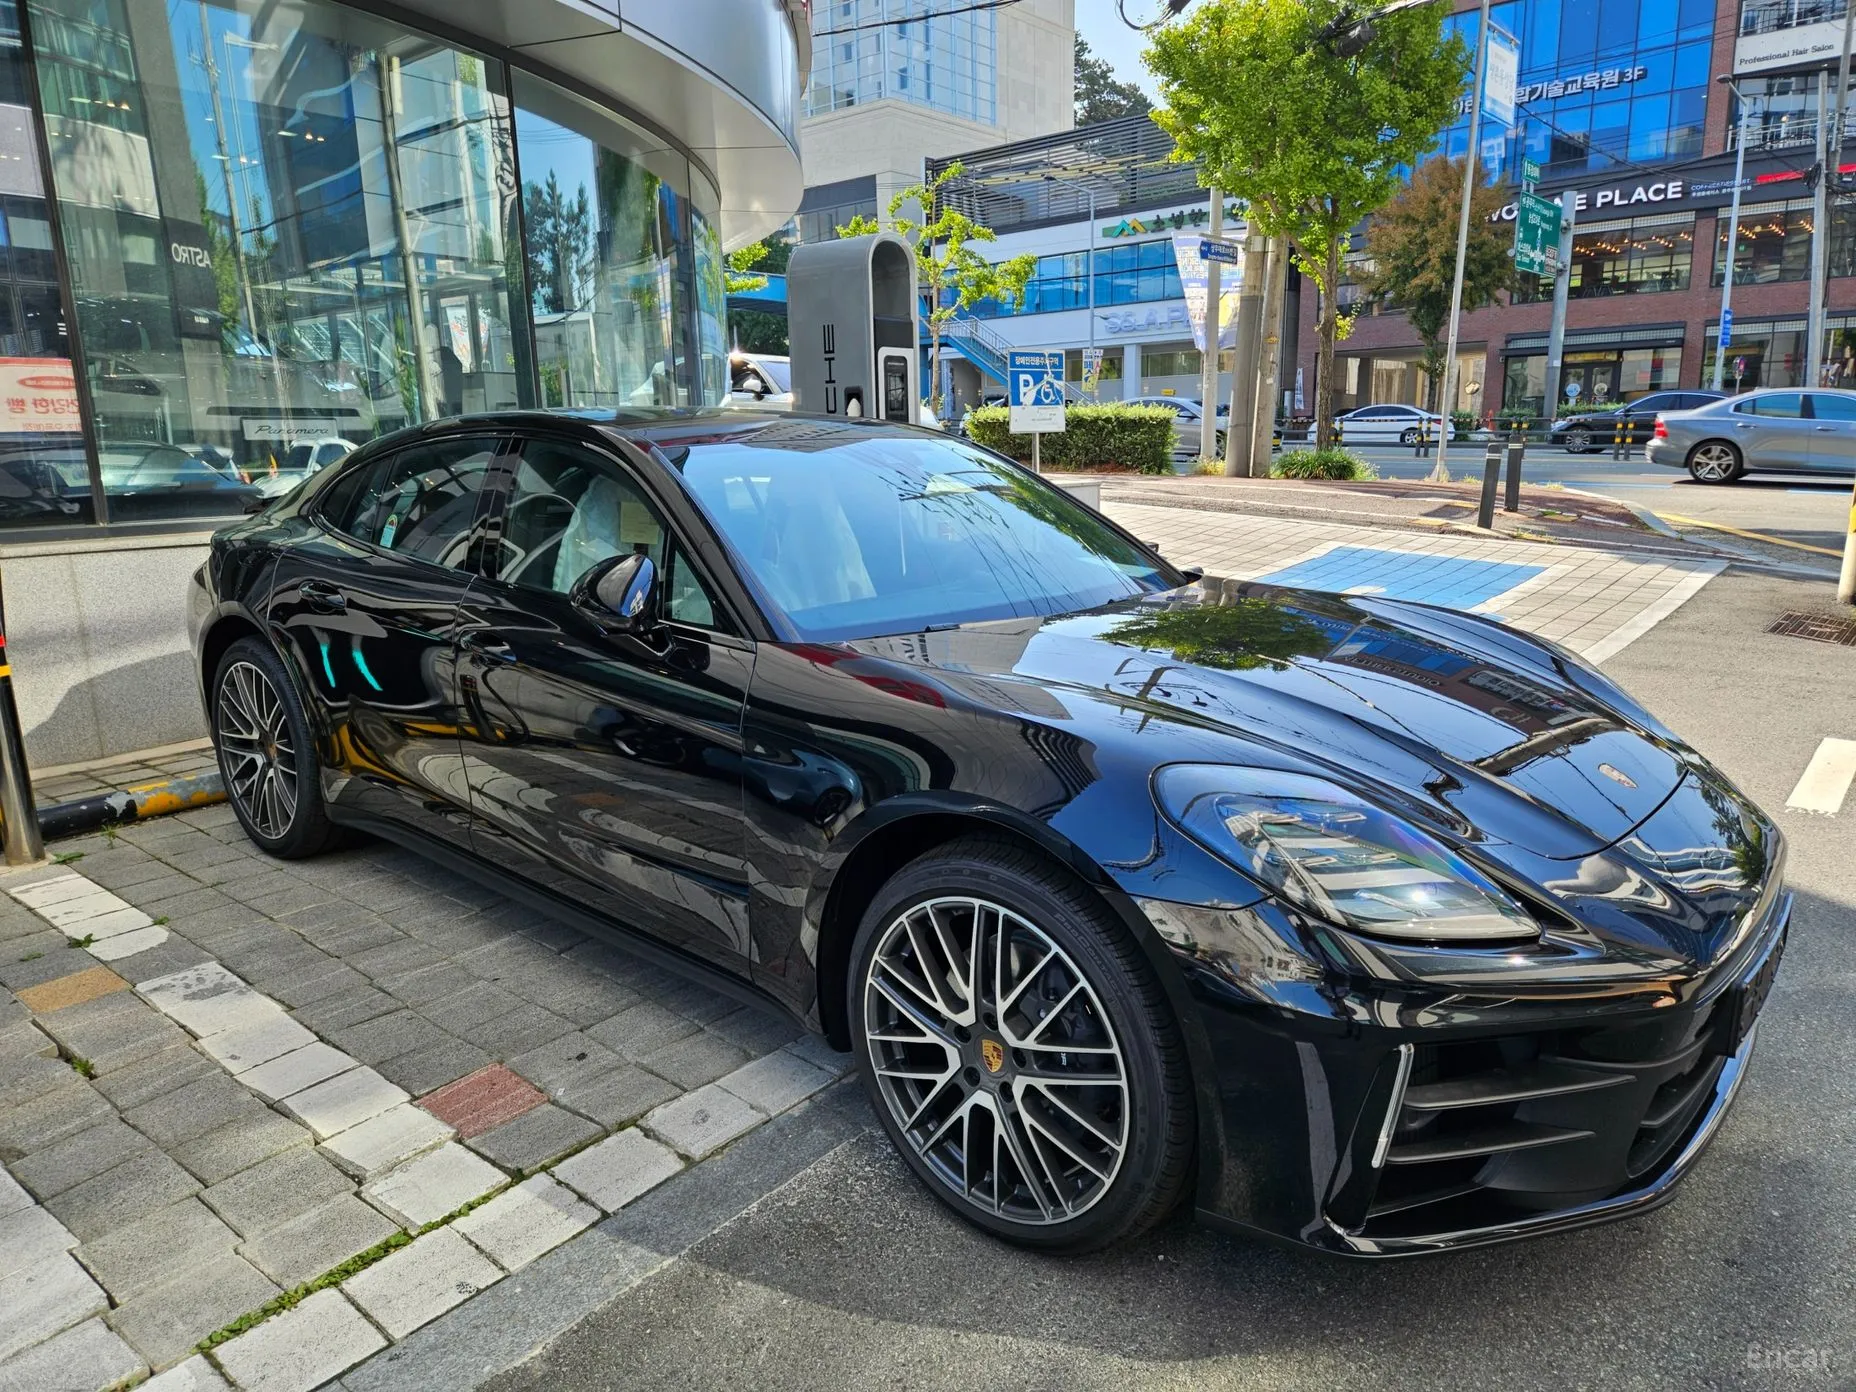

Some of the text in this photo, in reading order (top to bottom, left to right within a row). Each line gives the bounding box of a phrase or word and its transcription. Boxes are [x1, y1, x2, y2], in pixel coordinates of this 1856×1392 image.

[1739, 44, 1834, 65] Professional Hair Salon
[1623, 66, 1645, 83] 3F
[1595, 181, 1683, 208] PLACE
[1019, 373, 1034, 404] P
[254, 425, 329, 435] Panamera
